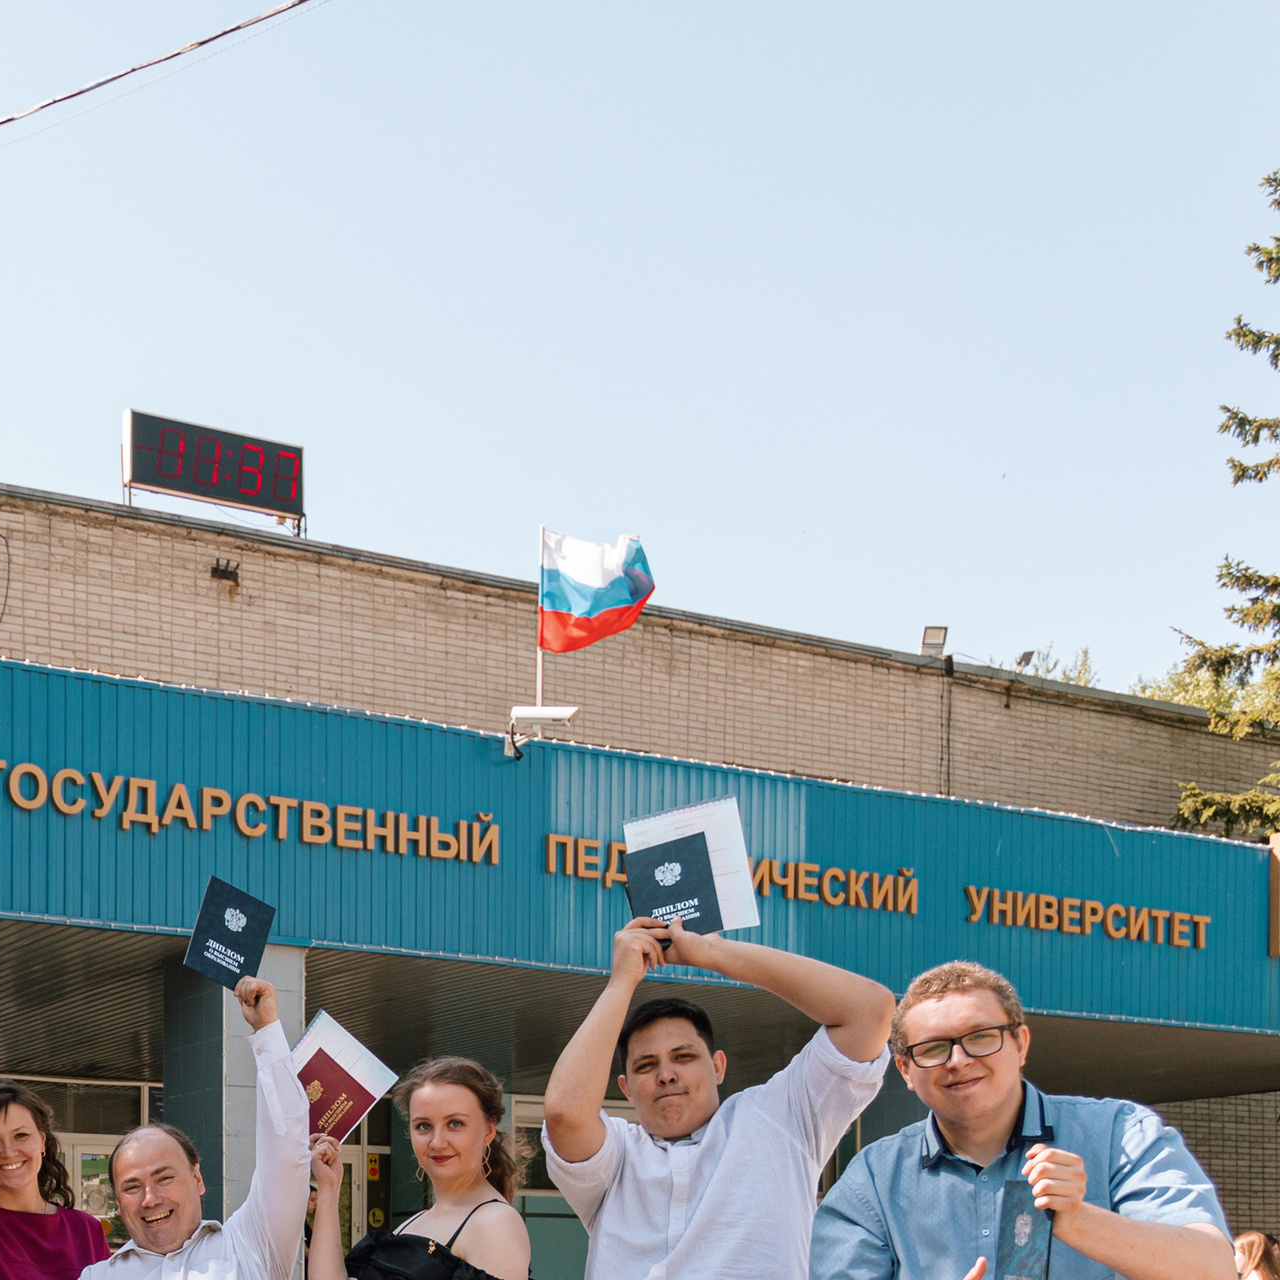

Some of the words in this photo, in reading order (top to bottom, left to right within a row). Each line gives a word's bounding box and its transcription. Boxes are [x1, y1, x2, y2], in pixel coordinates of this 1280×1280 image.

[176, 438, 300, 502] 11:37
[545, 833, 918, 915] ПЕДИЧЕСКИЙ
[965, 884, 1212, 949] УНИВЕРСИТЕТ
[651, 897, 699, 919] ДИПЛОМ
[205, 938, 245, 964] ДИПЛОМ
[317, 1092, 348, 1129] ДИПЛОМ
